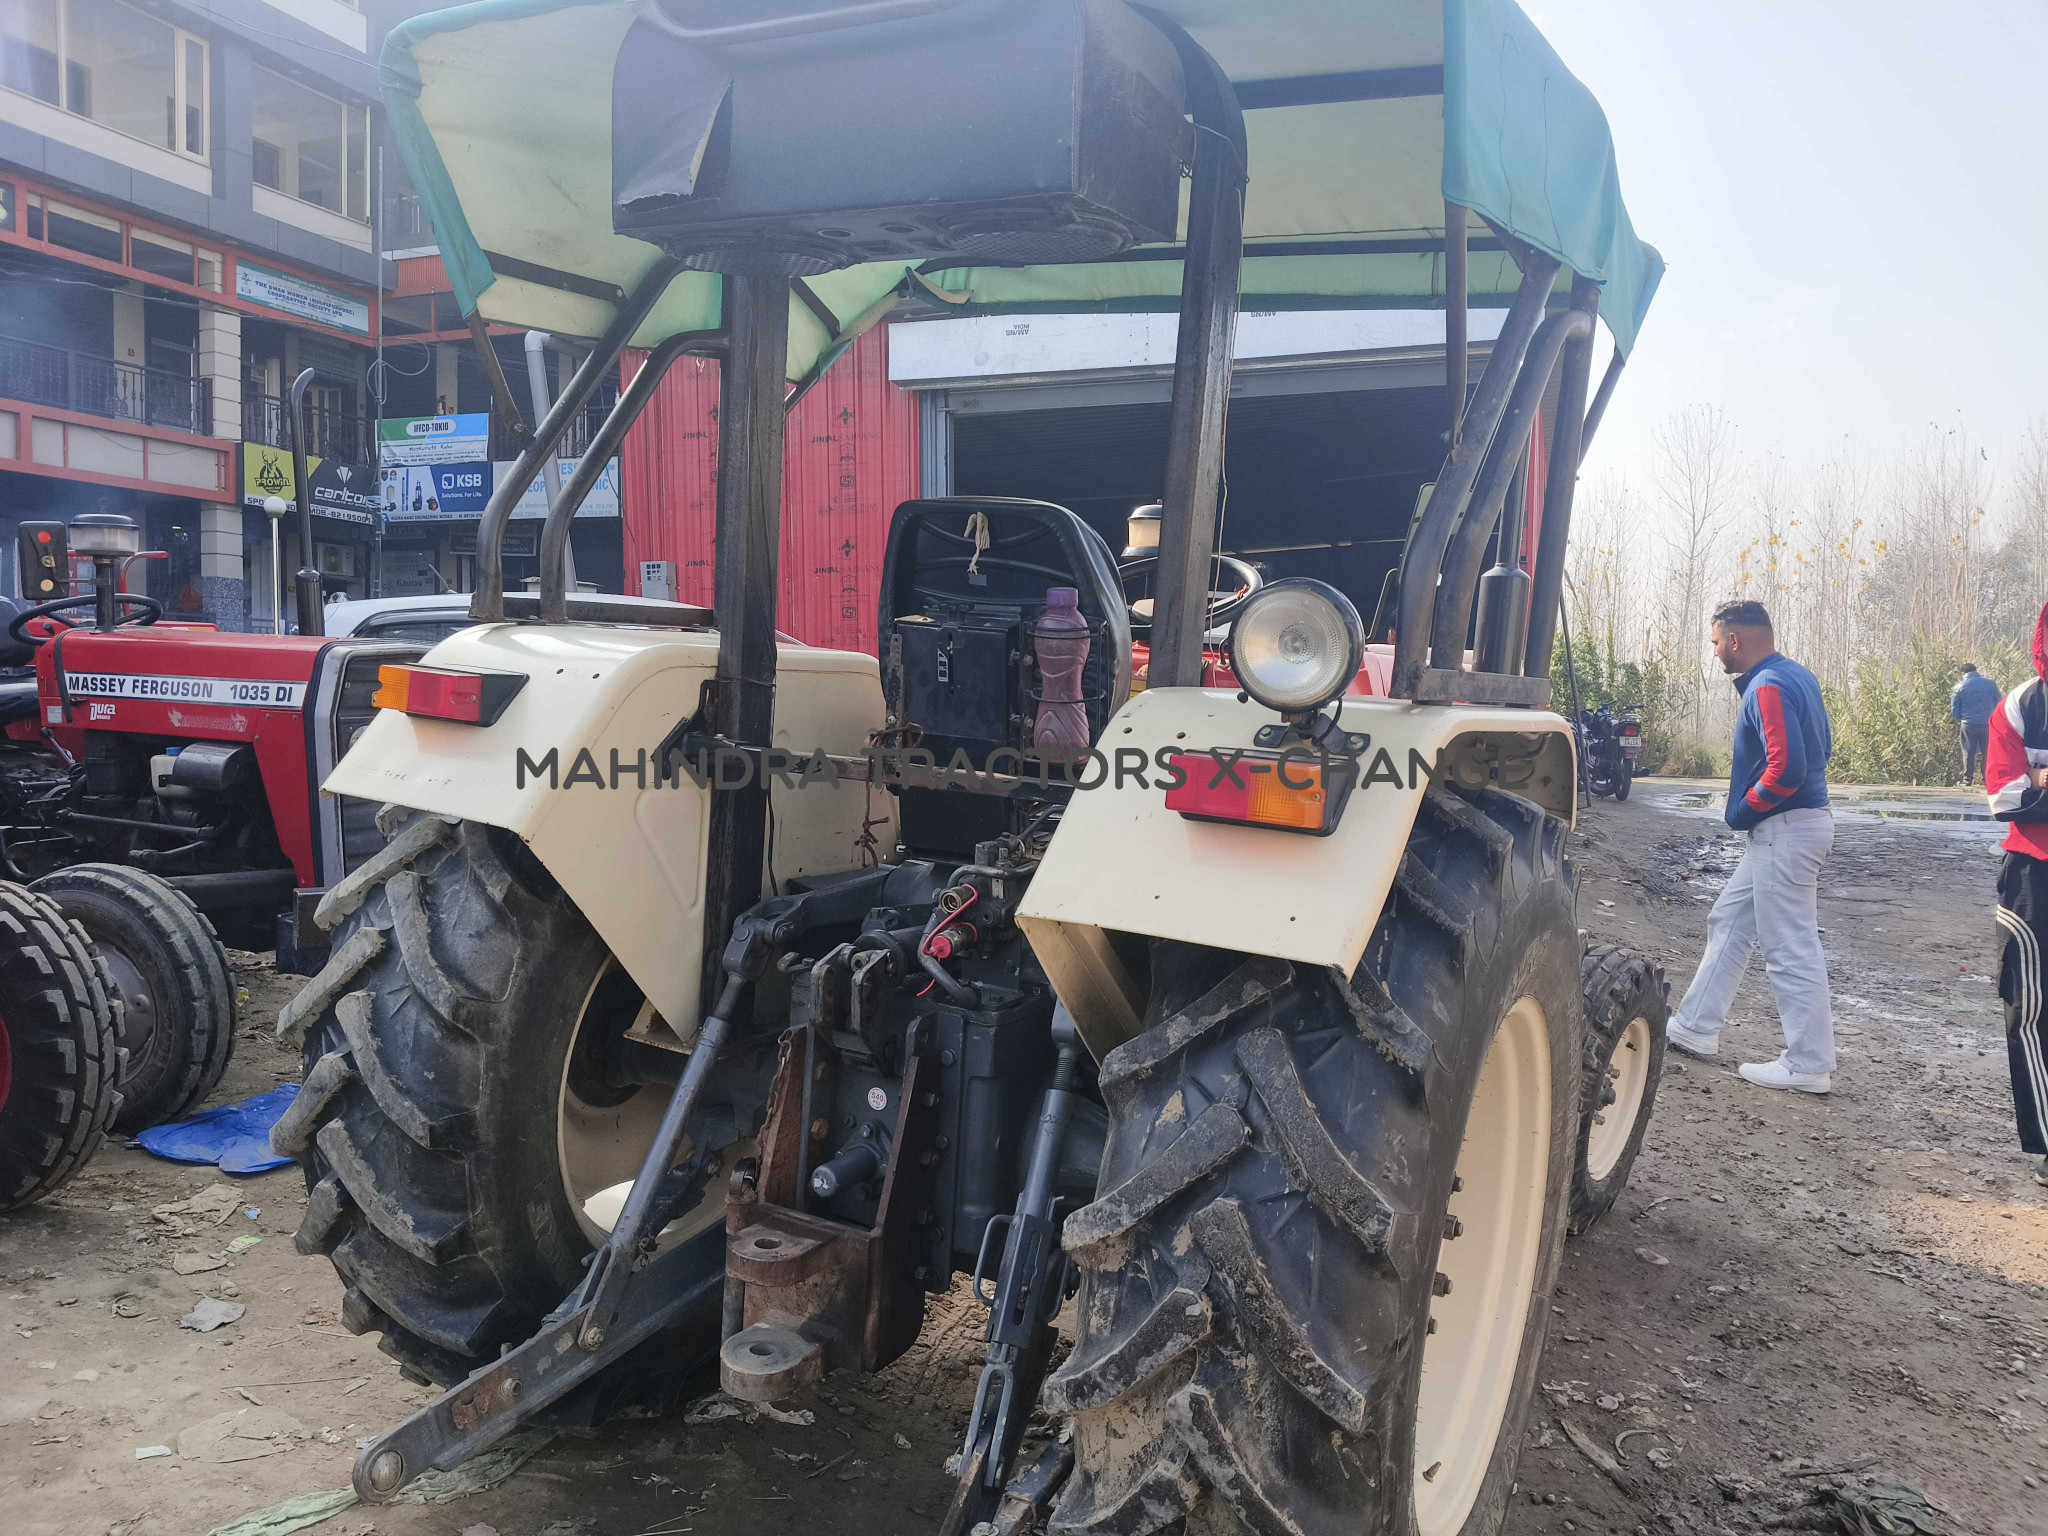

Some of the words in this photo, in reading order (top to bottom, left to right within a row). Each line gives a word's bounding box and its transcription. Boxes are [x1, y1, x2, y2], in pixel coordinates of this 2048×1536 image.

[254, 280, 268, 289] THE
[286, 288, 308, 300] WOMEN
[267, 290, 307, 306] COOPERATIVE
[307, 301, 331, 314] SOCIETY
[332, 309, 344, 317] LTD.
[413, 421, 449, 433] IFFCO-TOKIO
[456, 473, 482, 488] KSB
[396, 578, 423, 587] Gaurav
[68, 676, 126, 693] MASSEY
[131, 678, 214, 699] FERGUSON
[229, 684, 270, 702] 1035
[275, 686, 293, 703] DI
[90, 703, 116, 721] Dura
[870, 1091, 884, 1103] 540
